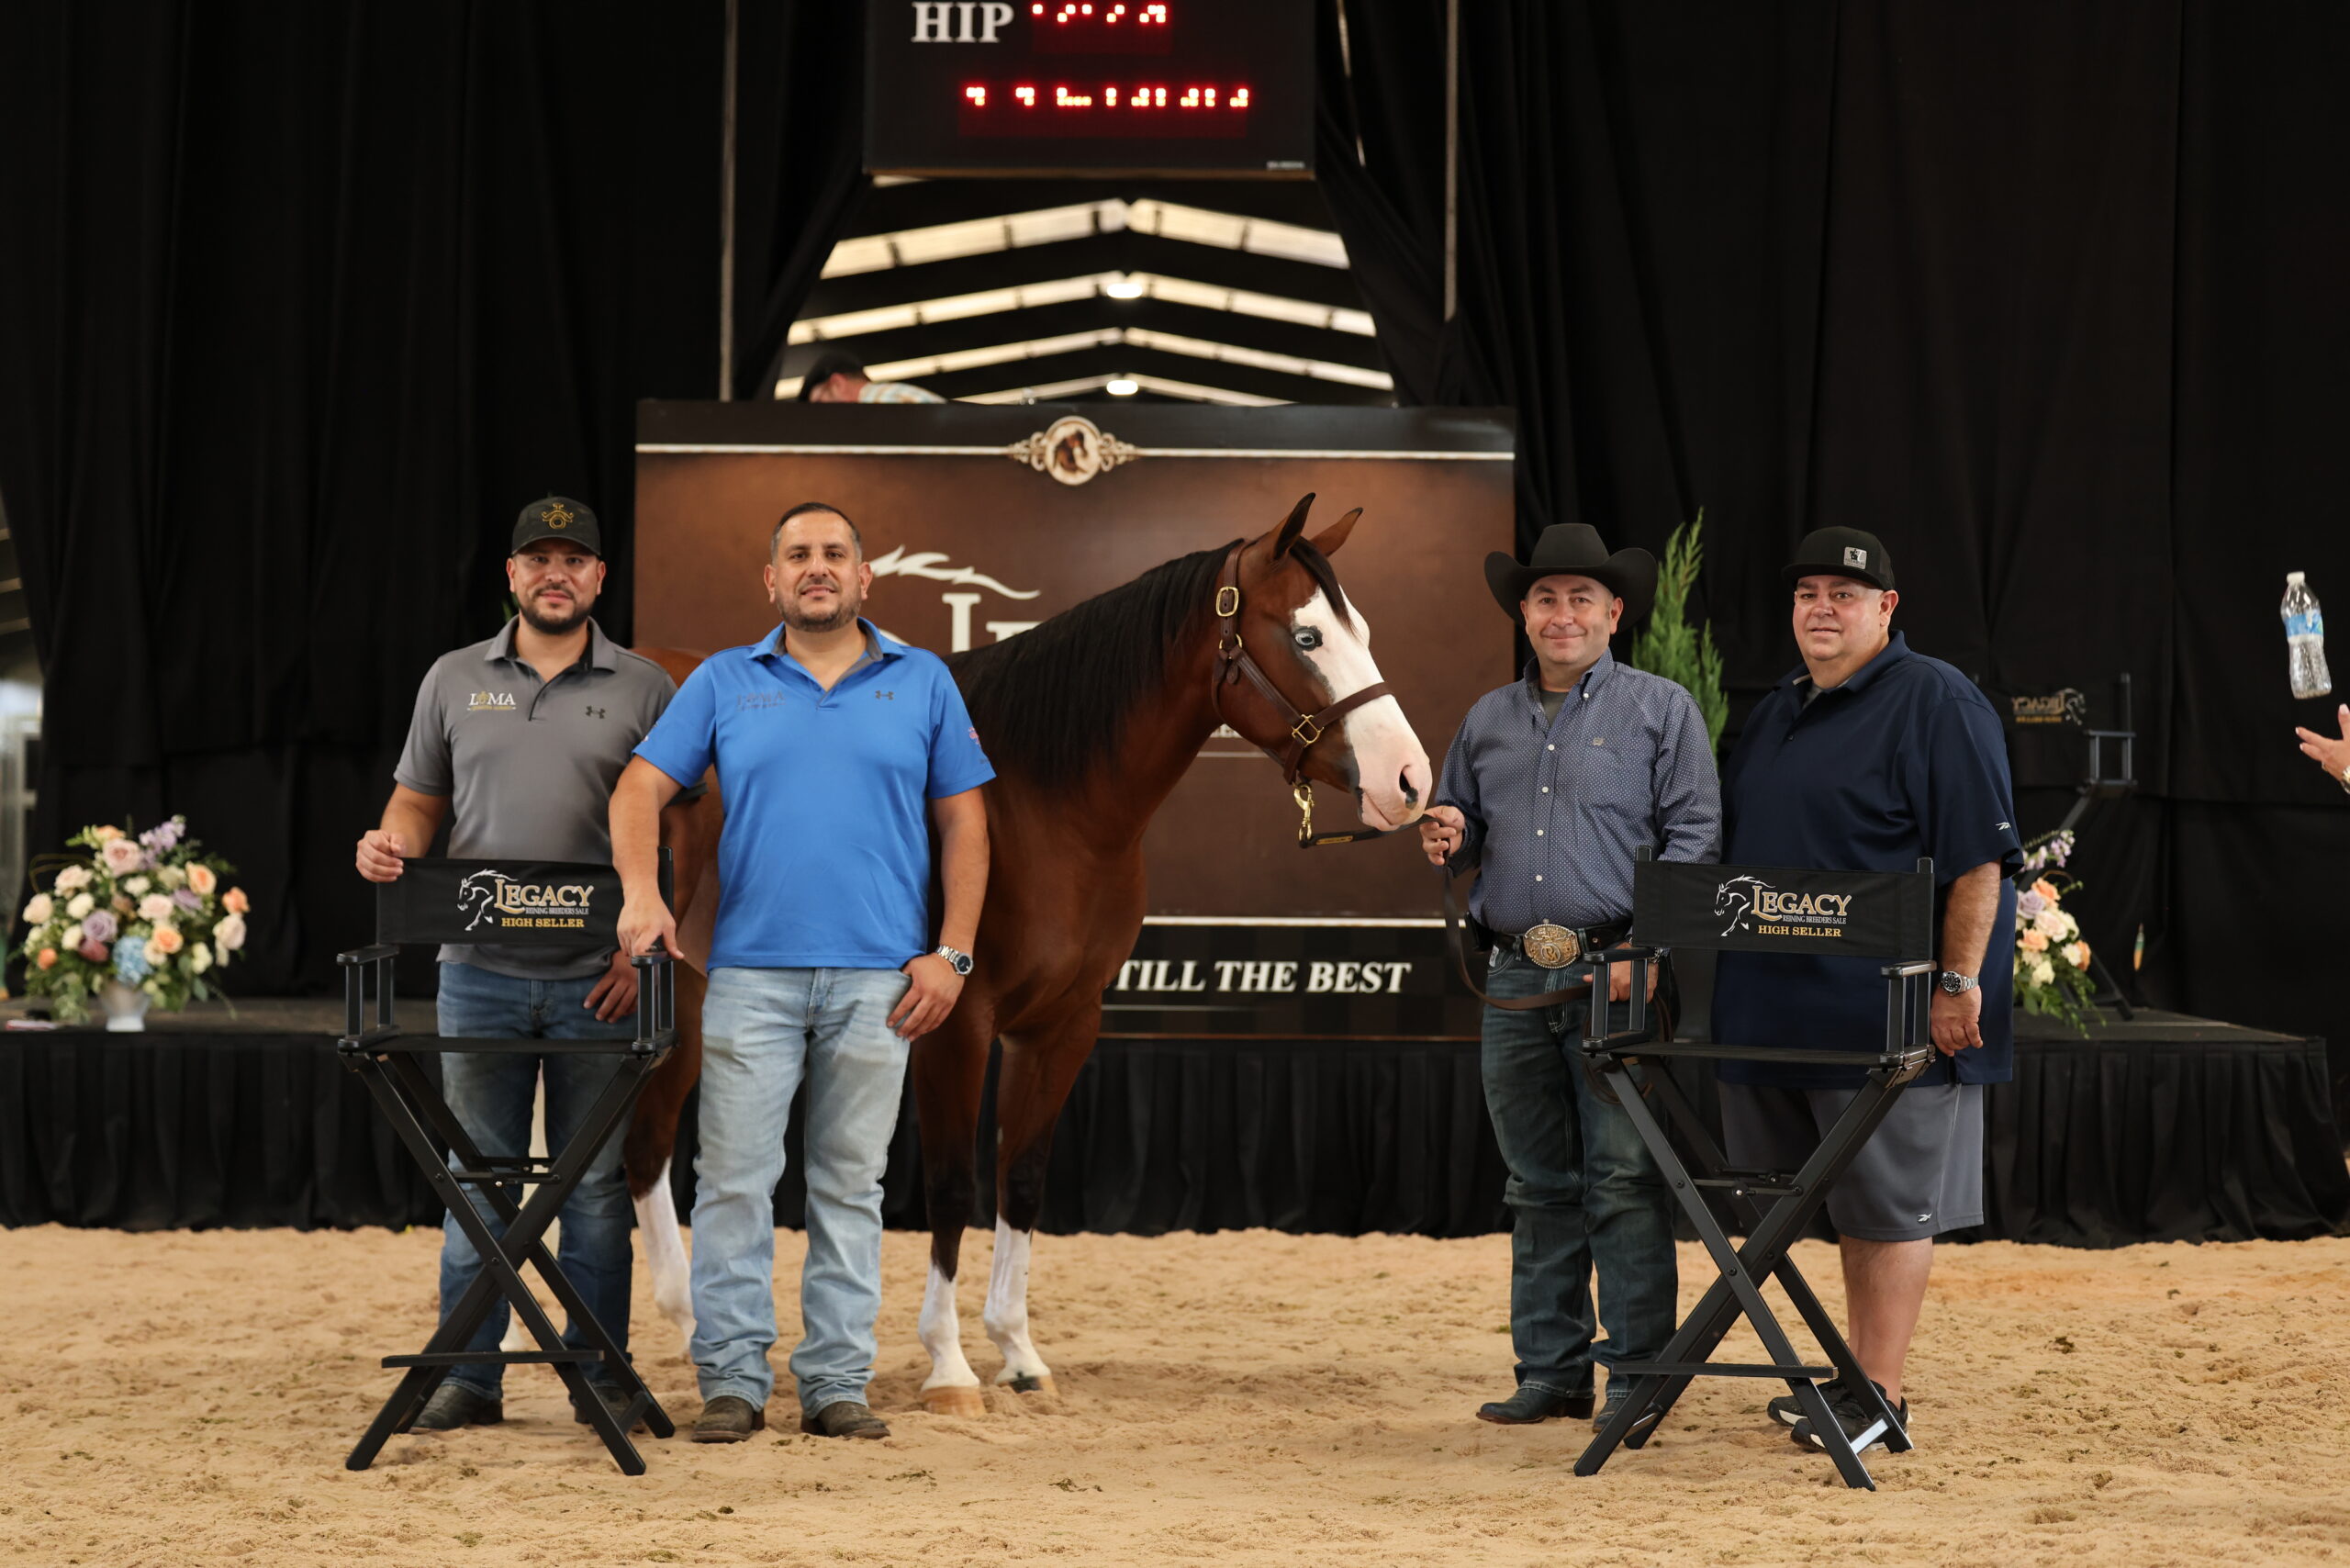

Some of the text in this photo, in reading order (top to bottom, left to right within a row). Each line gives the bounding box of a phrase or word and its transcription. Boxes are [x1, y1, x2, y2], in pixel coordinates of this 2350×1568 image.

[911, 1, 1014, 43] HIP
[494, 879, 595, 914] LEGACY
[575, 907, 589, 915] SALE
[1751, 885, 1852, 922] LEGACY
[501, 917, 585, 928] HIGH SELLER
[1758, 924, 1842, 937] HIGH SELLER
[1115, 959, 1413, 993] TILL THE BEST
